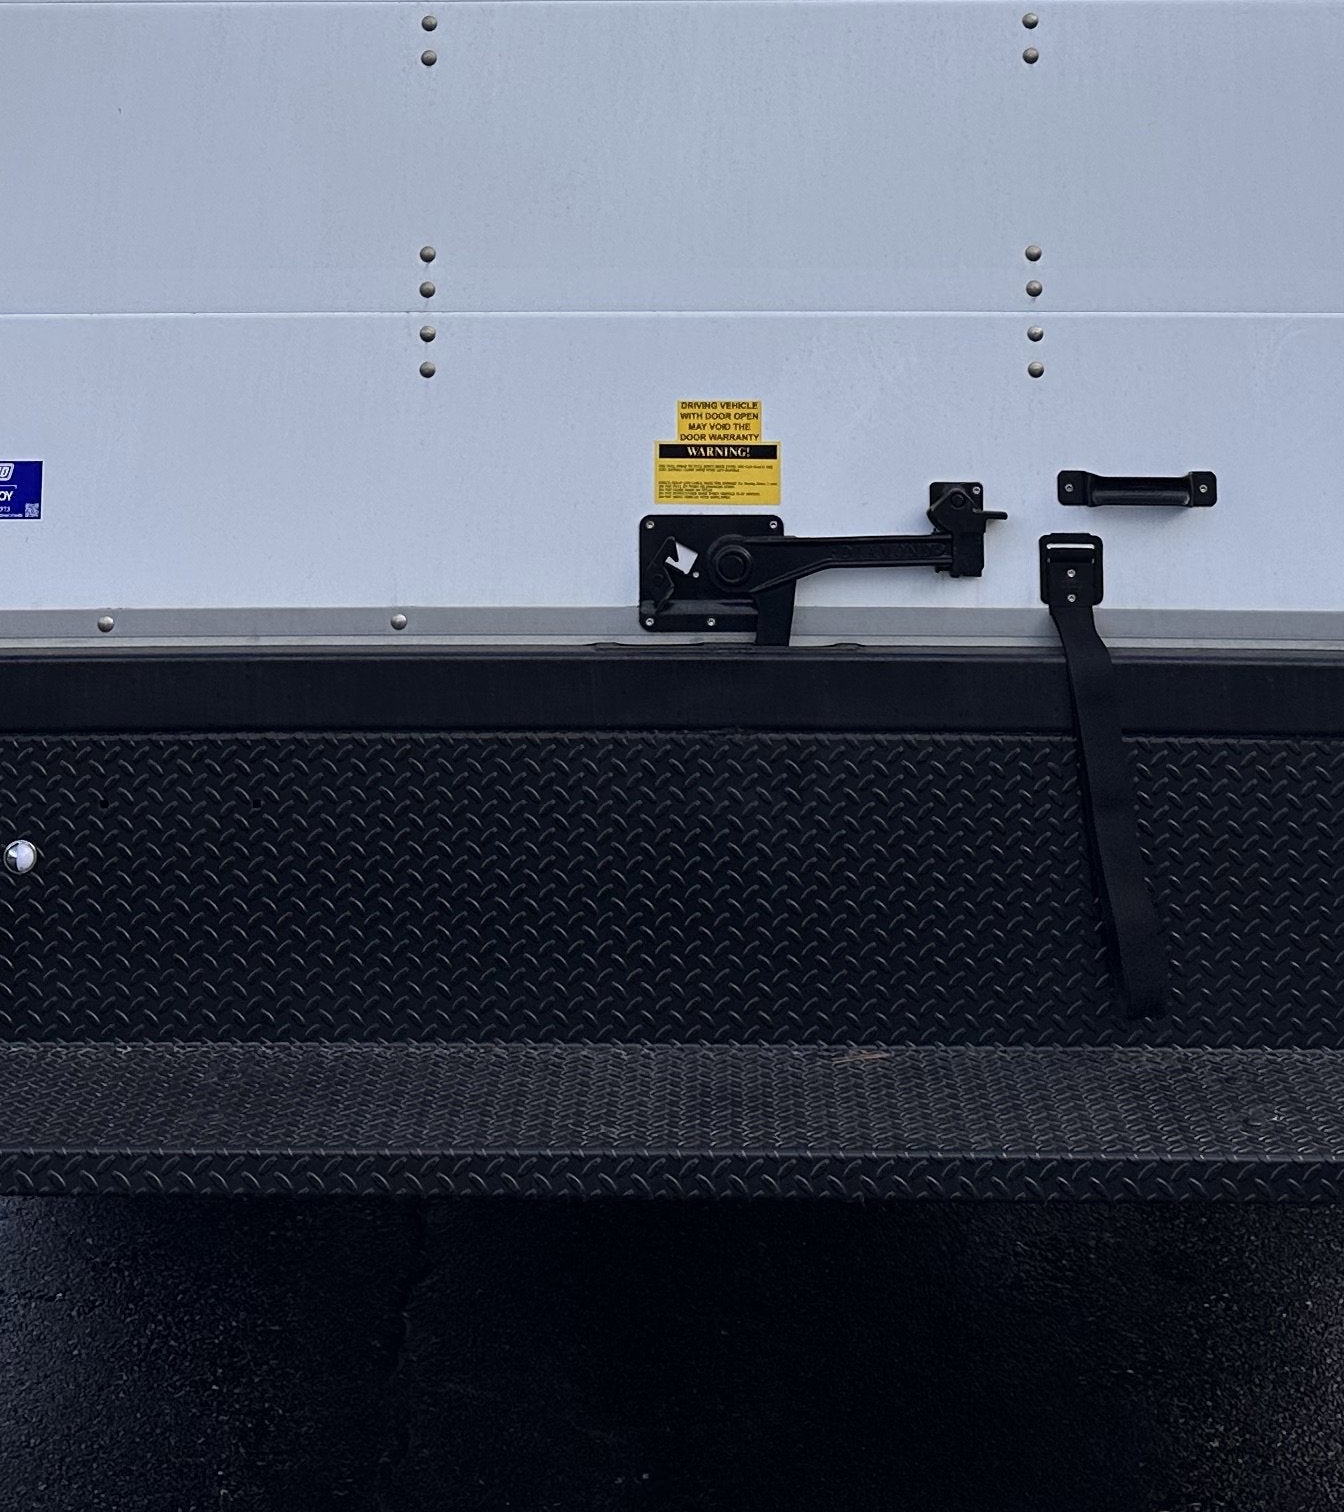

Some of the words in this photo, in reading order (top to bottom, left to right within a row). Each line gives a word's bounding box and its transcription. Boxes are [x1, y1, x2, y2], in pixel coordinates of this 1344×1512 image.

[681, 402, 718, 410] DRIVING
[720, 402, 759, 410] VEHICLE
[680, 412, 703, 420] WITH
[705, 412, 732, 420] DOOR
[733, 412, 759, 420] OPEN
[688, 423, 707, 431] MAY
[709, 423, 731, 431] VOID
[733, 423, 751, 431] THE
[680, 433, 707, 441] DOOR
[708, 433, 760, 441] WARRANTY
[687, 446, 751, 458] WARNING!
